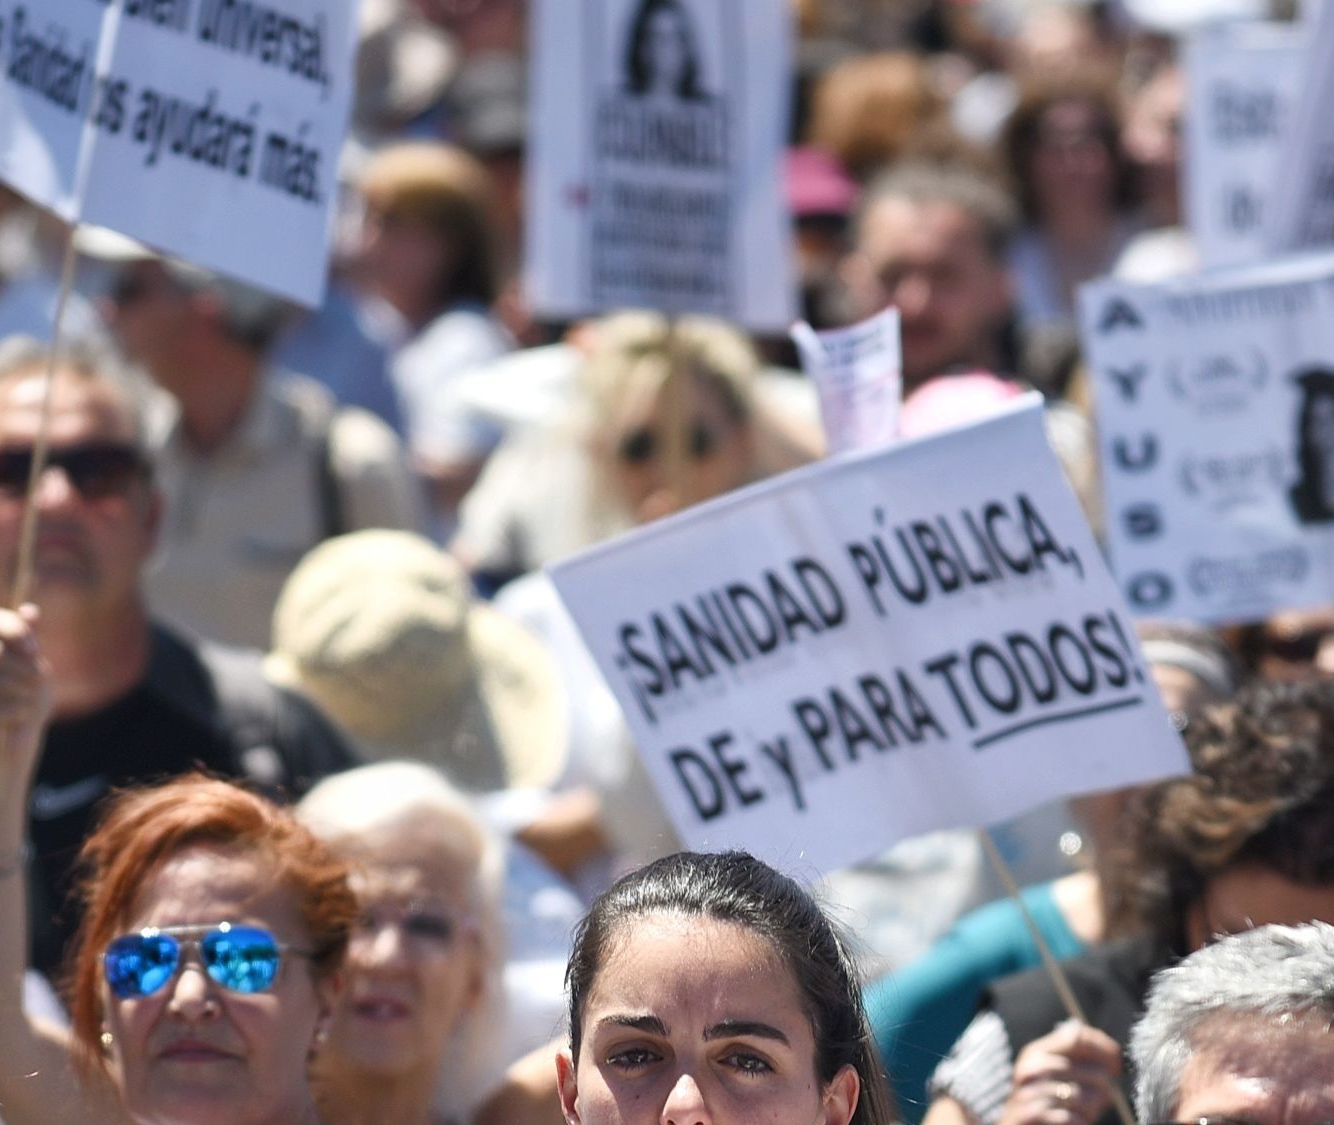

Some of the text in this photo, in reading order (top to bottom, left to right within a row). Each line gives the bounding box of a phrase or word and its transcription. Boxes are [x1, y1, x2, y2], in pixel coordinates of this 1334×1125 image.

[615, 493, 1085, 726] ¡SANIDAD PÚBLICA,
[668, 730, 764, 822] DE
[792, 667, 948, 772] PARA
[926, 608, 1145, 730] TODOS!
